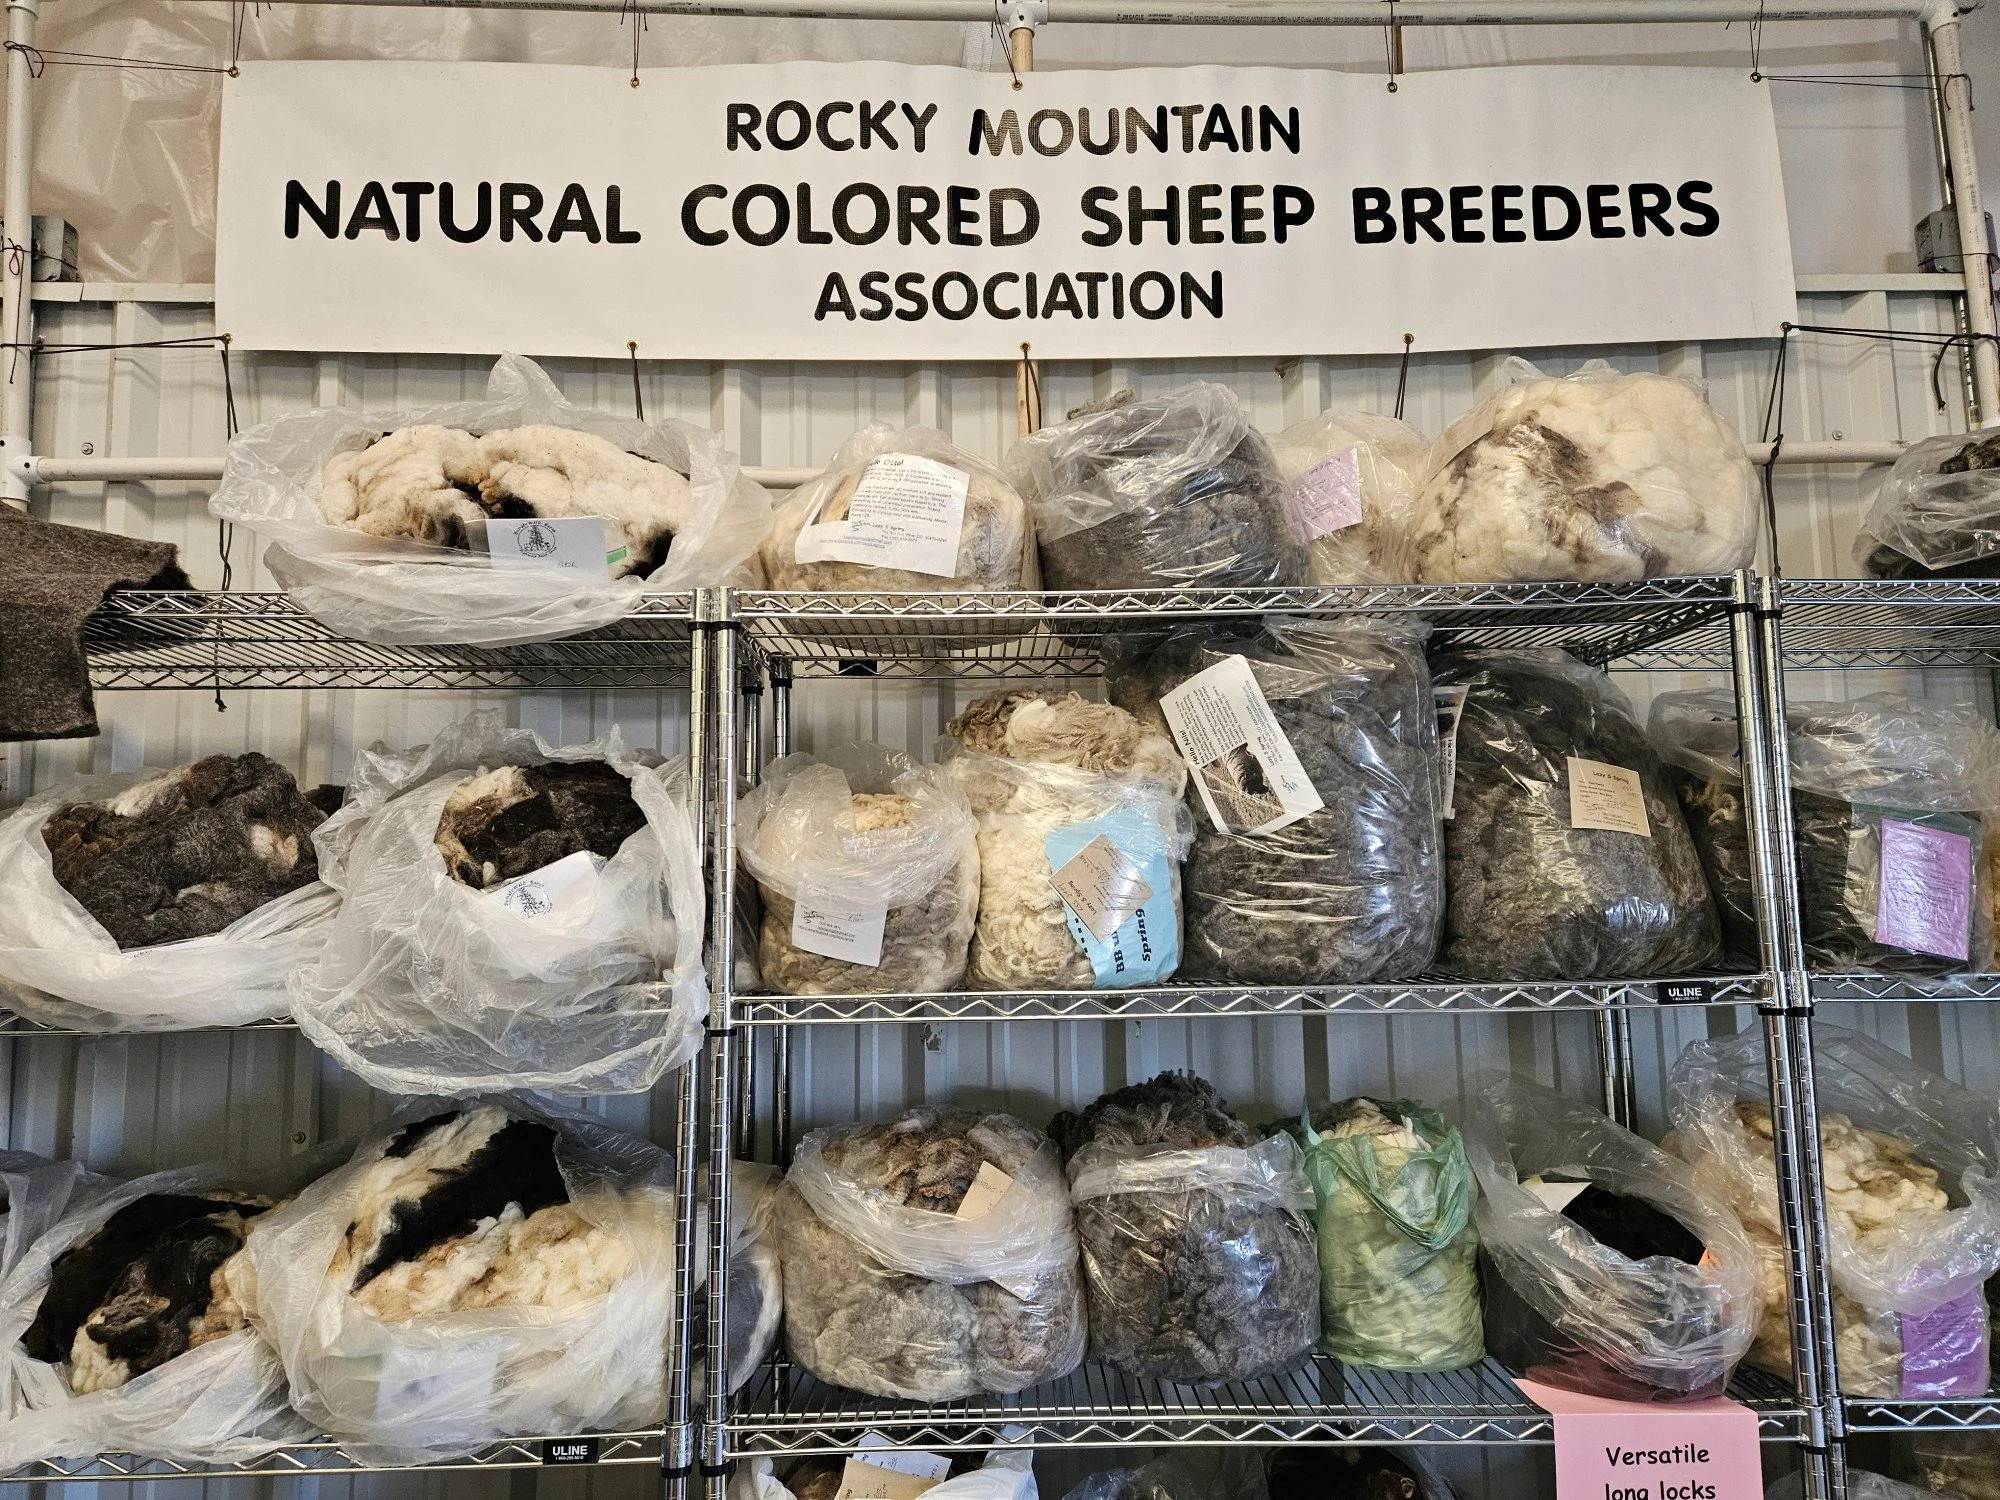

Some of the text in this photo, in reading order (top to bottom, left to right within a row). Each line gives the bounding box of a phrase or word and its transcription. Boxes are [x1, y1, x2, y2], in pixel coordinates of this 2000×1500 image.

[726, 99, 1301, 157] ROCKY MOUNTAIN
[284, 179, 1720, 248] NATURAL COLORED SHEEP BREEDERS
[814, 269, 1224, 322] ASSOCIATION
[1178, 729, 1191, 746] Nils!
[1187, 746, 1201, 765] Hello
[1135, 909, 1151, 962] Spring
[1115, 949, 1125, 974] BB
[1668, 988, 1702, 997] ULINE
[552, 1445, 588, 1456] ULINE
[1606, 1443, 1710, 1466] Versatile
[1605, 1480, 1716, 1500] long locks
